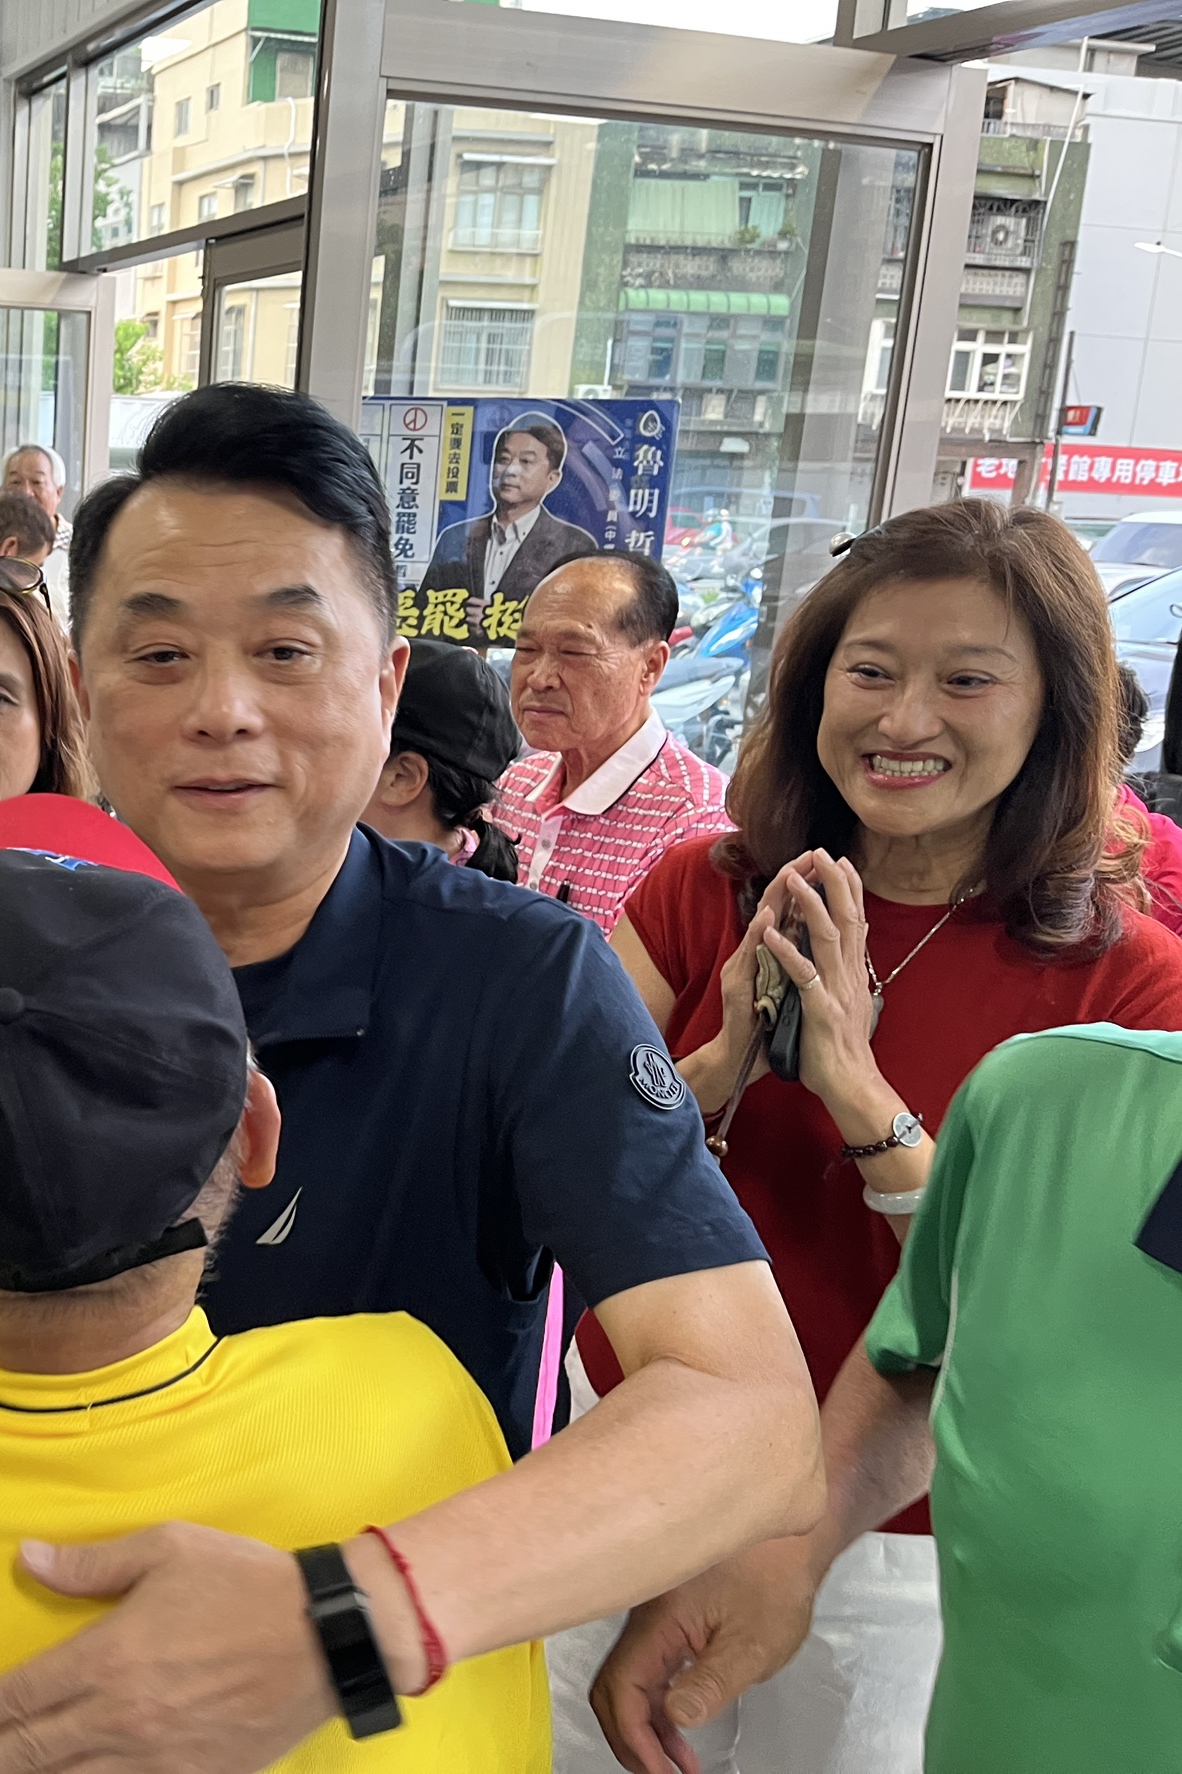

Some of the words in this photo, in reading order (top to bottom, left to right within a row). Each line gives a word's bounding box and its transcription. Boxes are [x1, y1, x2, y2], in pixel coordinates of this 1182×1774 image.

[393, 436, 425, 559] 不同意罷免
[624, 444, 665, 556] 魯明哲
